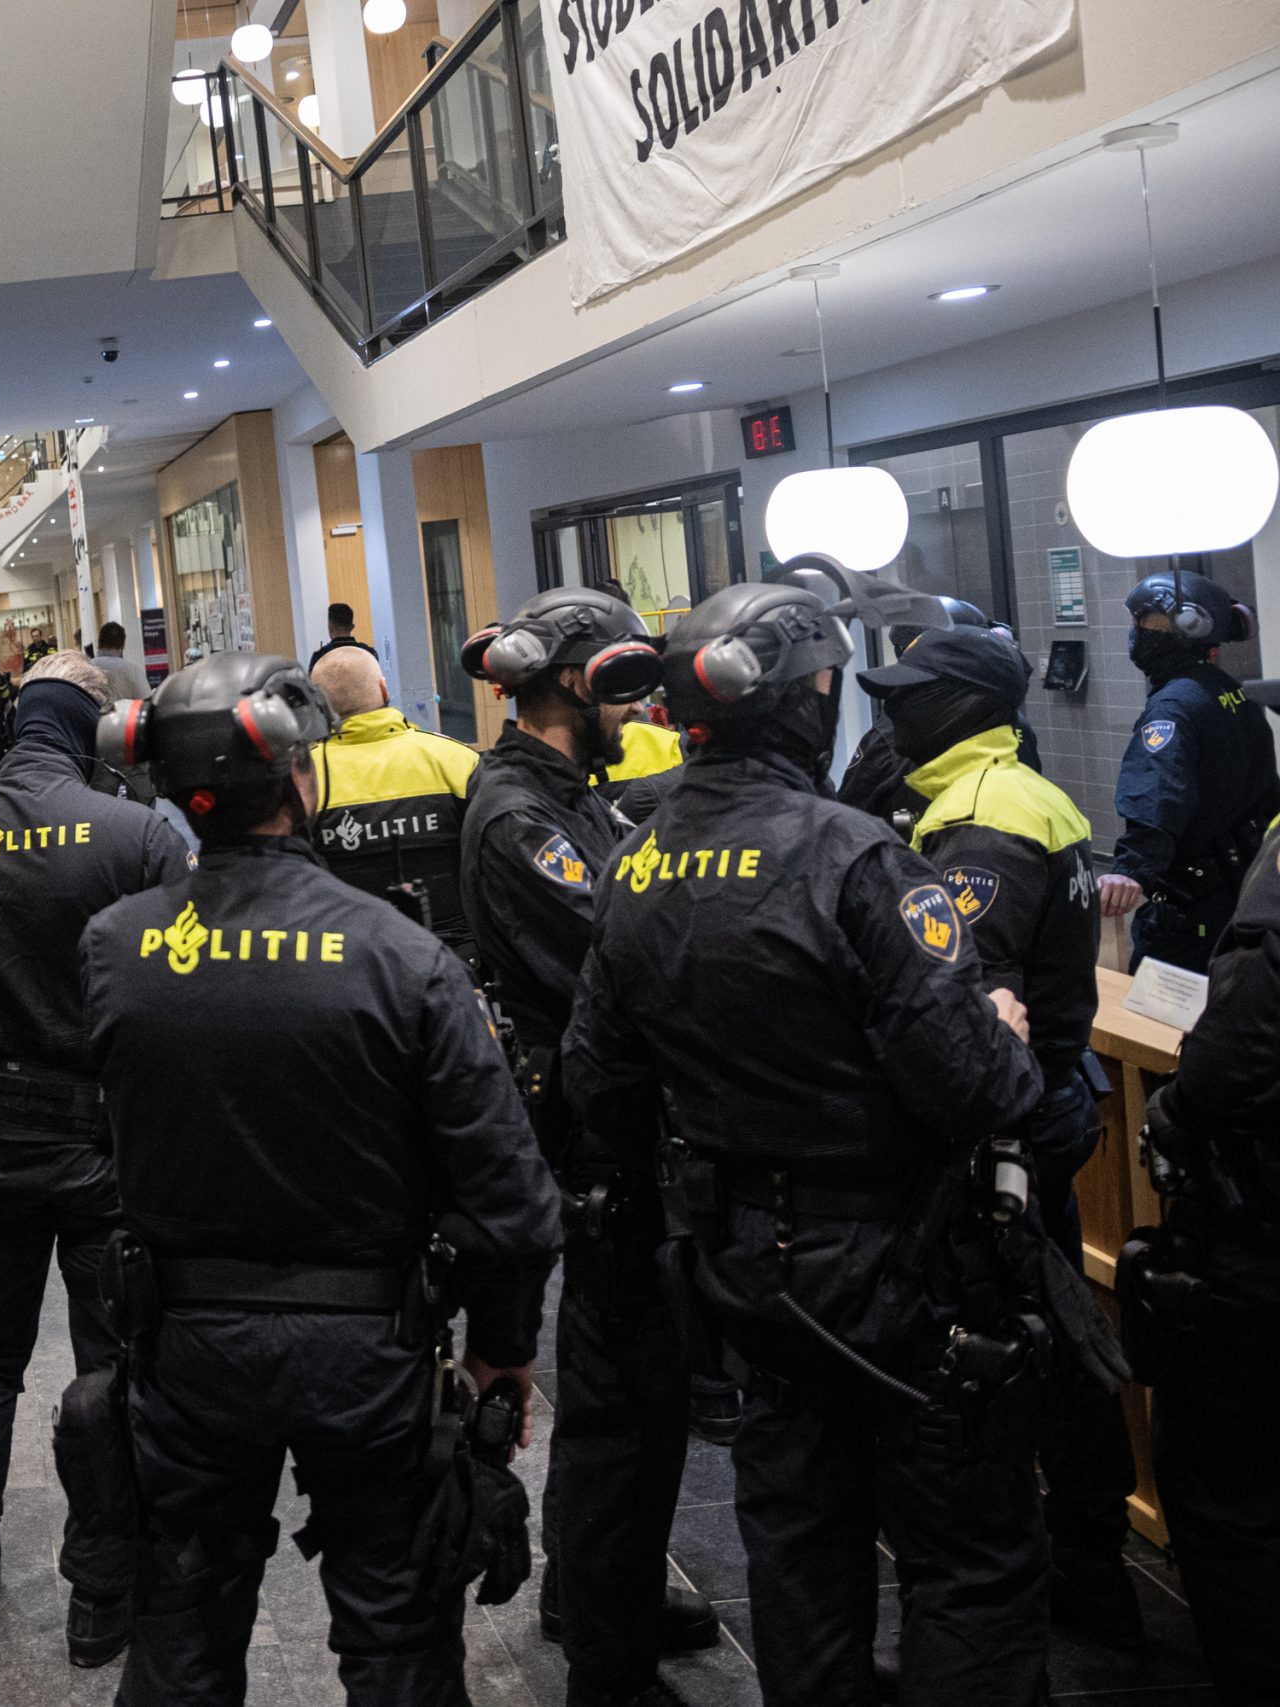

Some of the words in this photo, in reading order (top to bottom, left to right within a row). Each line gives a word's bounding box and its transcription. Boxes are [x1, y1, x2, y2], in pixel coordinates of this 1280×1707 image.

[322, 809, 439, 851] POLITIE
[615, 829, 761, 893] POLITIE
[140, 900, 345, 974] POLITIE
